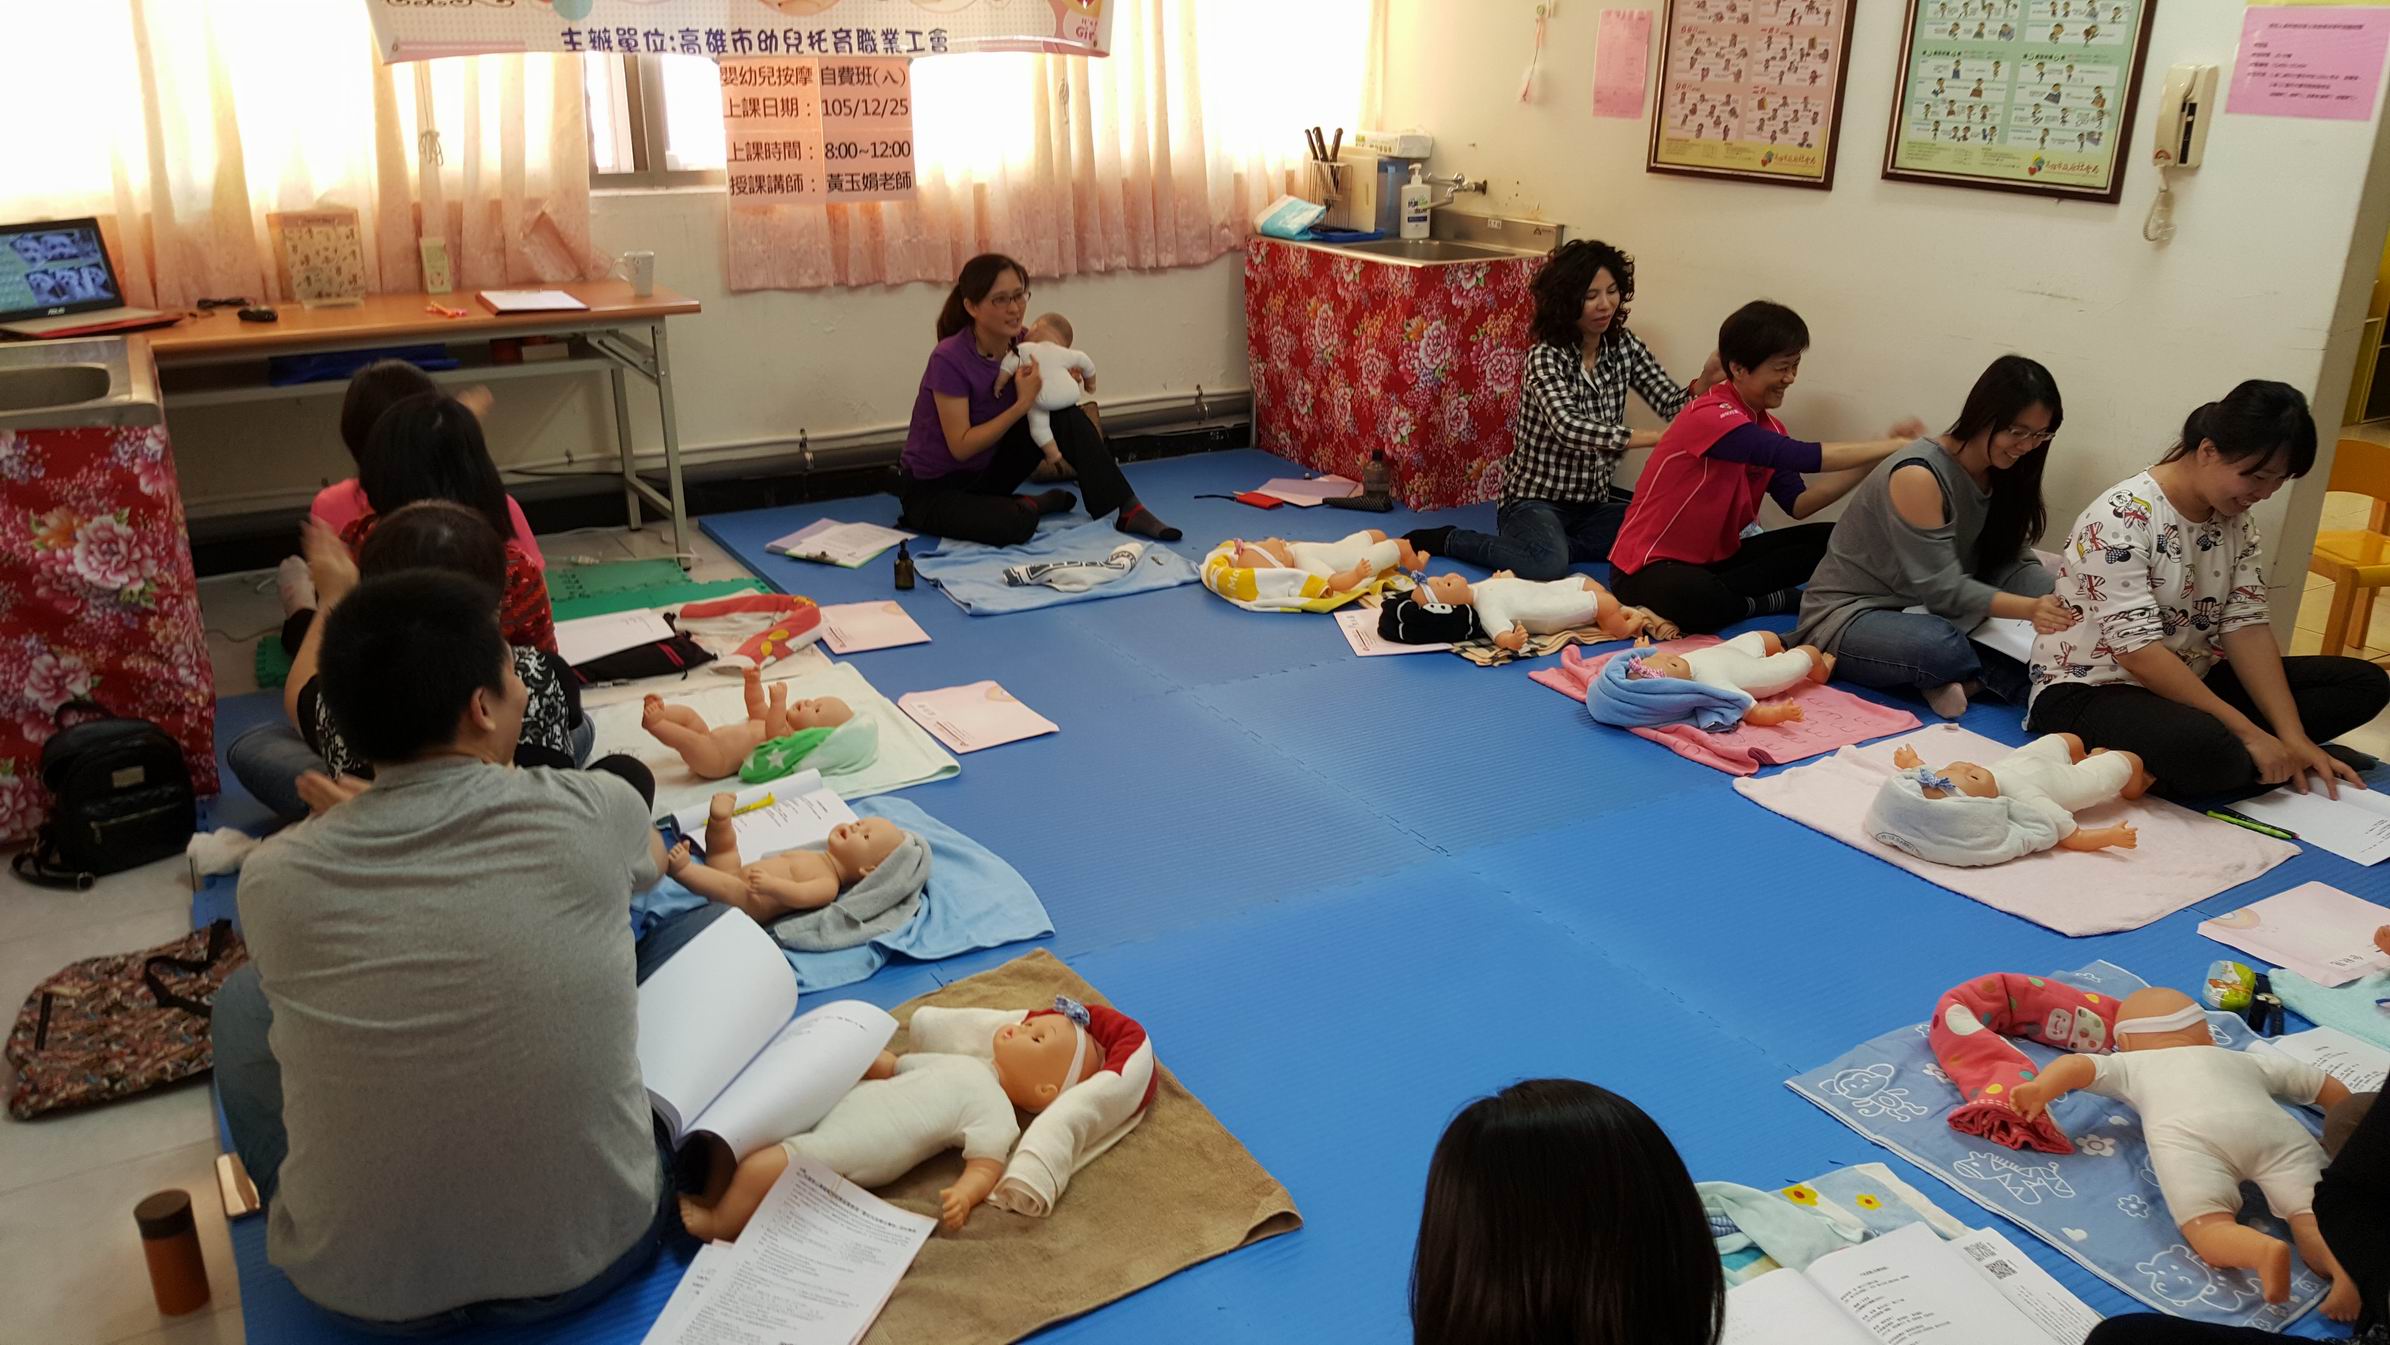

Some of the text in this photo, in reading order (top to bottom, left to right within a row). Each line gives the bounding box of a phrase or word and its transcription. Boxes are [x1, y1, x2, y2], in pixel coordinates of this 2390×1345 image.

[720, 65, 813, 87] 嬰幼兒按摩
[823, 98, 909, 118] 105/12/25
[825, 140, 911, 160] 8:00~12:00
[826, 171, 912, 193] 黃玉娟老師
